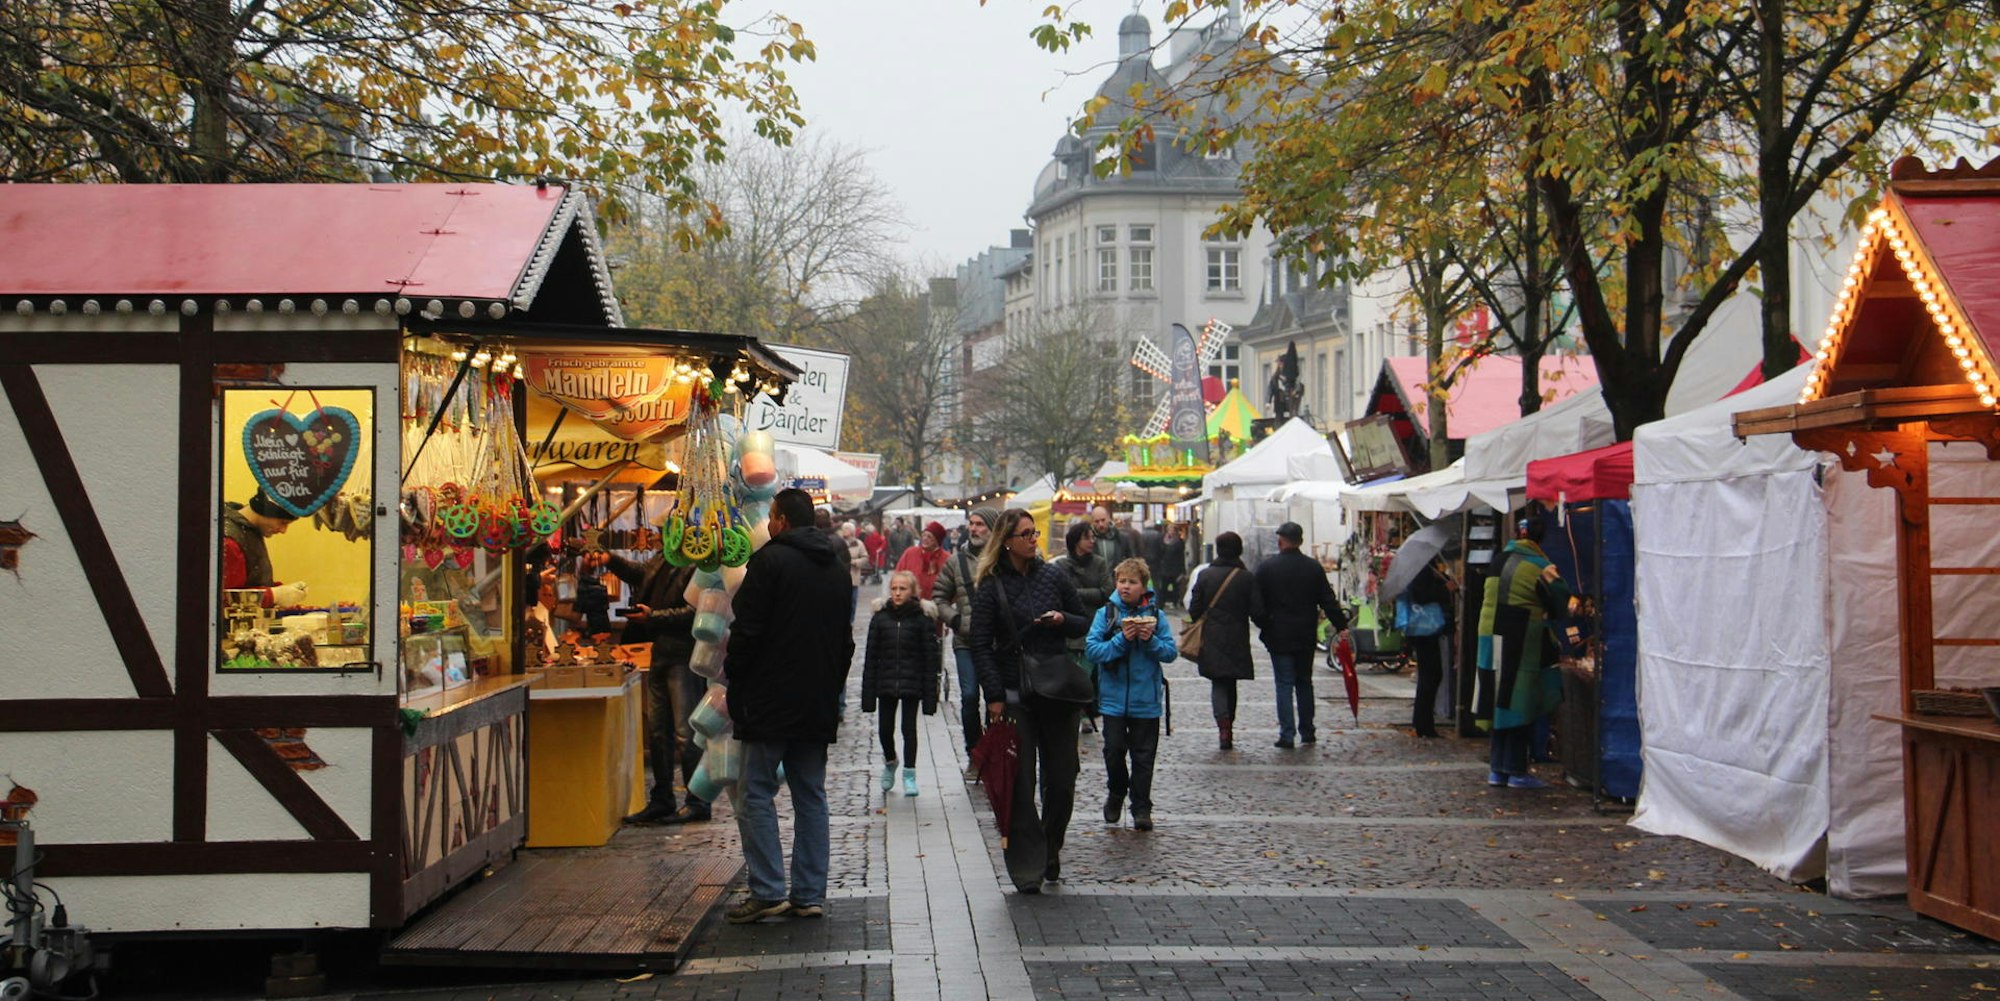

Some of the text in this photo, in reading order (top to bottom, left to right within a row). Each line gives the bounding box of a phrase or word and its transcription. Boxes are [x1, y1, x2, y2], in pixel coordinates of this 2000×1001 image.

[548, 358, 646, 369] Frisch gebrannte
[543, 368, 650, 400] Mandeln
[789, 390, 802, 405] &
[757, 406, 828, 436] Bänder
[254, 434, 286, 448] Mein
[263, 465, 310, 480] nur für
[275, 481, 312, 498] Dich
